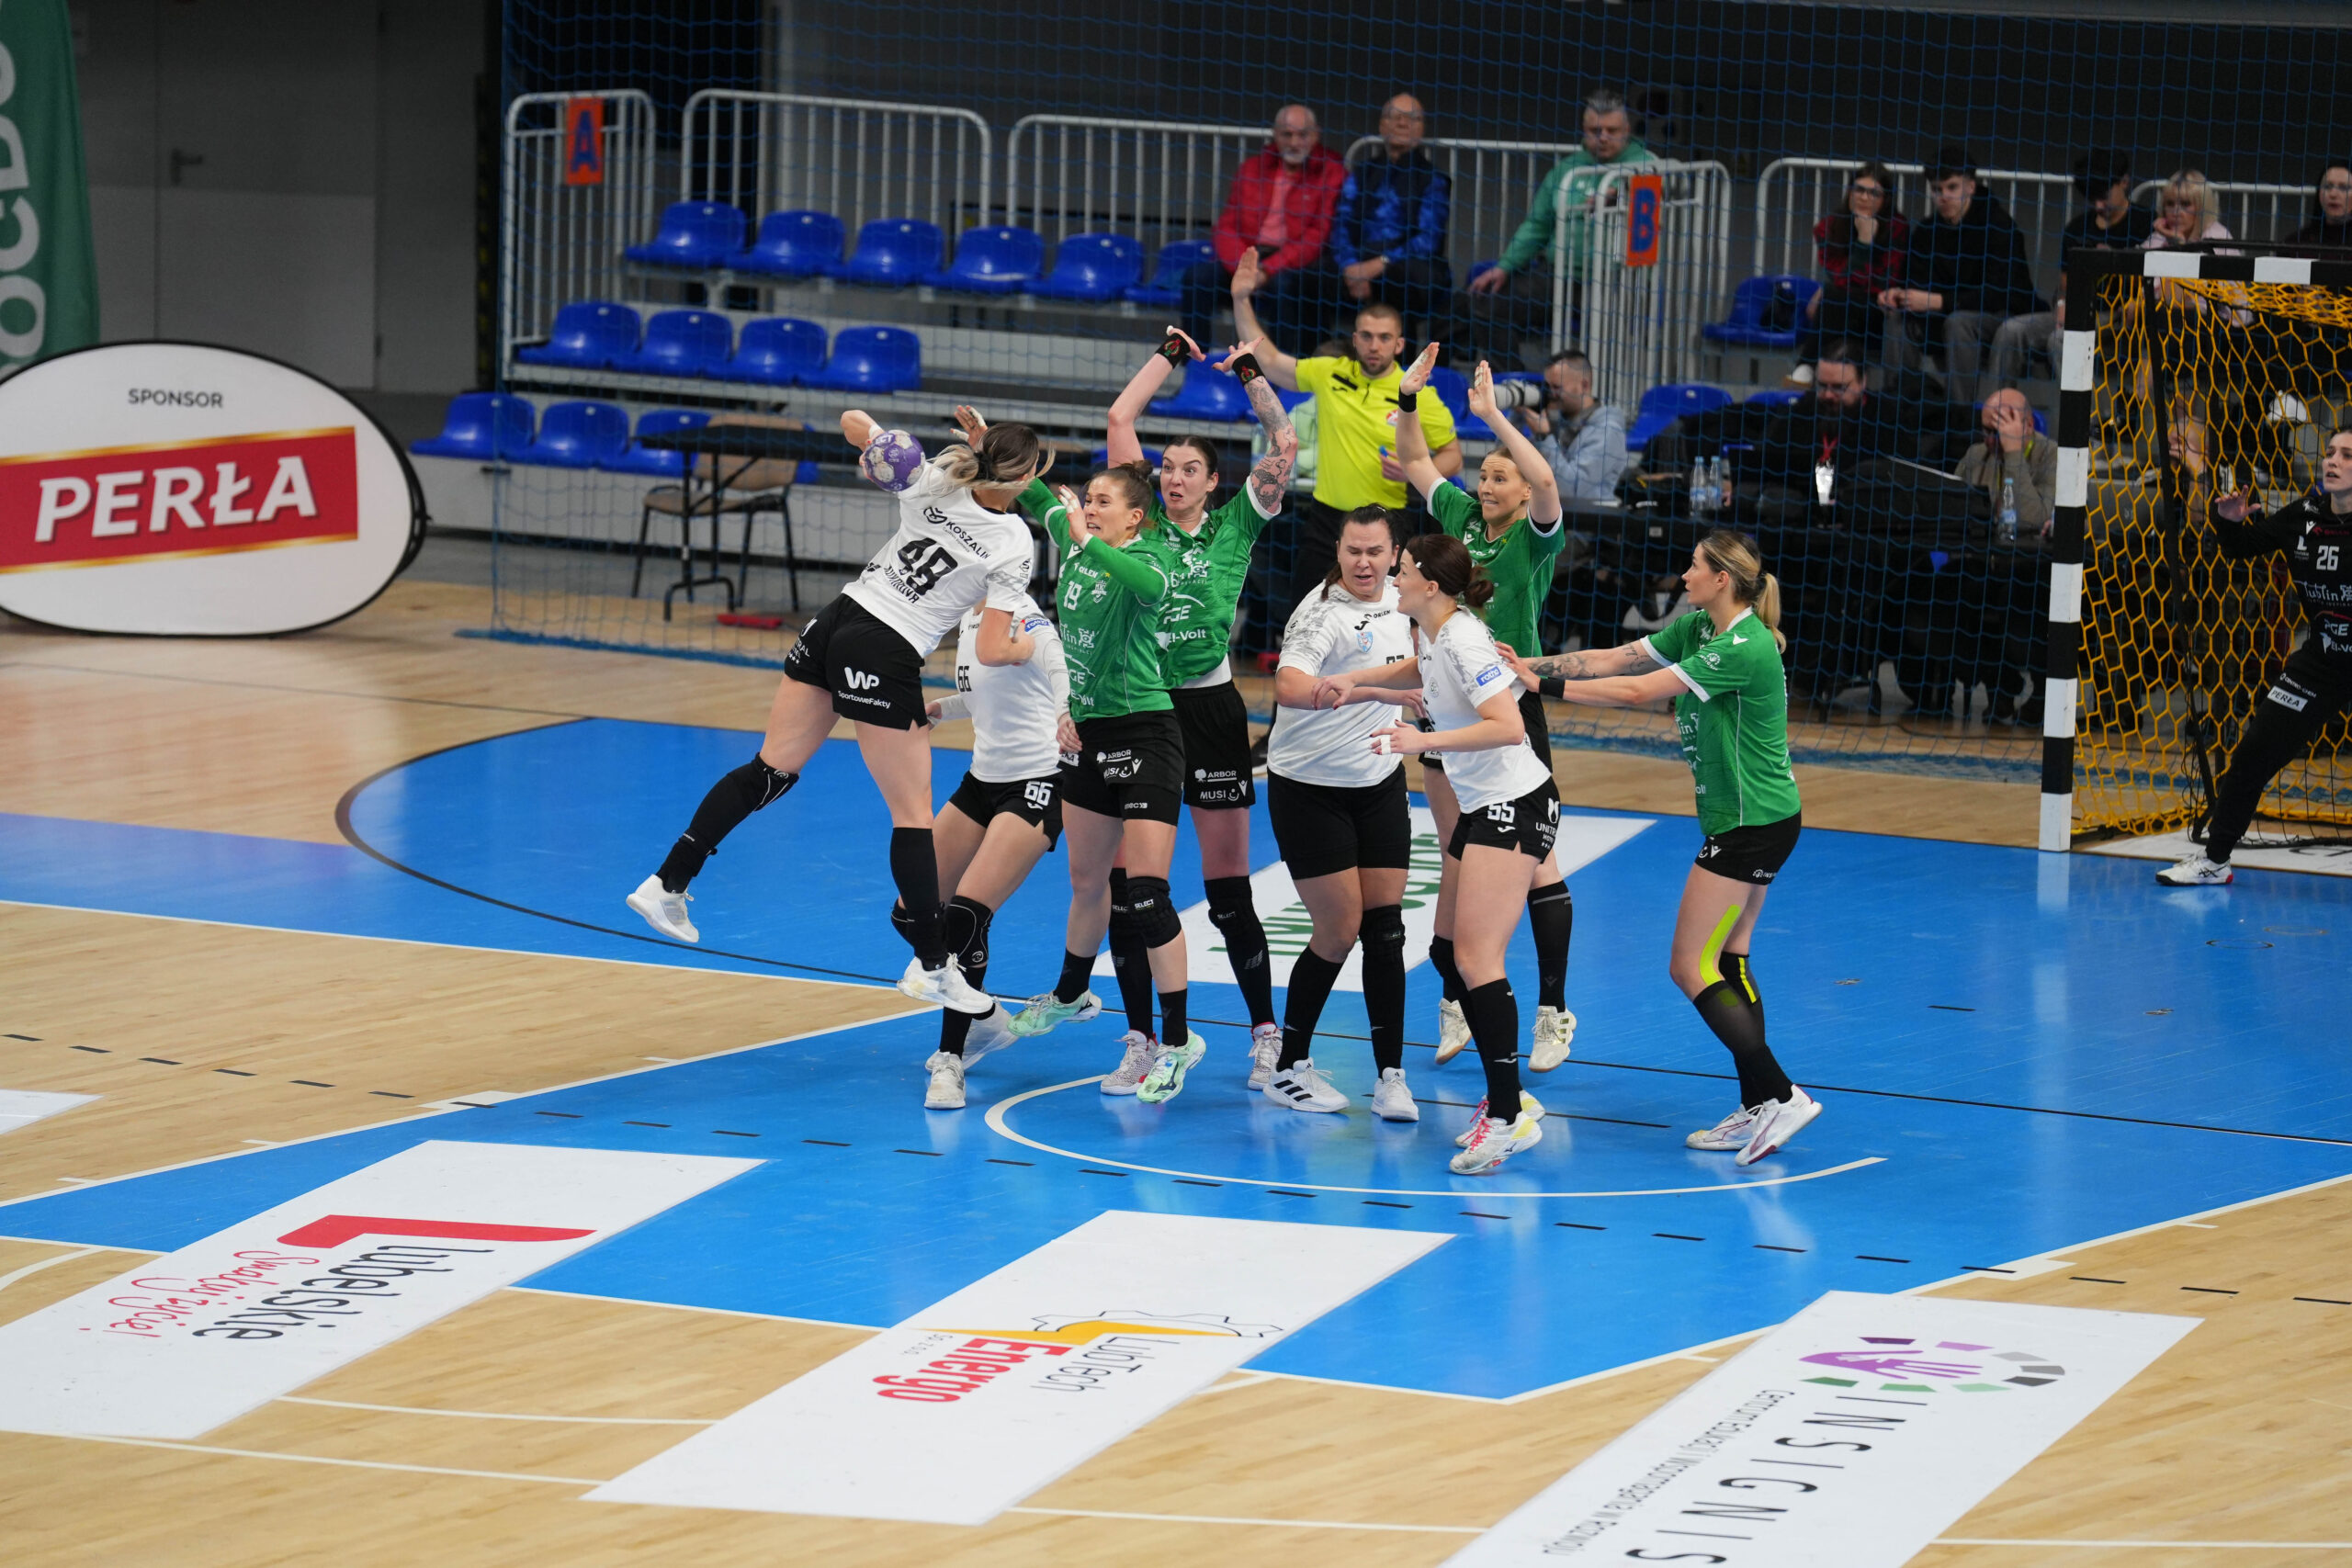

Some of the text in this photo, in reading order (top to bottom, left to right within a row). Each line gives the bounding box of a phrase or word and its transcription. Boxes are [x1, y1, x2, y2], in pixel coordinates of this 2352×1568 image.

[571, 110, 598, 173] A
[1631, 187, 1657, 254] B
[128, 389, 224, 409] SPONSOR
[34, 456, 317, 544] PERŁA
[946, 521, 990, 558] KOSZALIN
[2316, 545, 2340, 571] 26
[1063, 581, 1083, 611] 19
[1373, 609, 1391, 619] ORLEN
[843, 666, 880, 690] WP
[958, 665, 972, 693] 66
[1069, 669, 1086, 685] GE
[1480, 668, 1499, 682] rotho
[837, 690, 891, 709] SportoweFakty
[2270, 689, 2301, 707] PERŁA
[1107, 749, 1132, 760] ARBOR
[1207, 770, 1237, 779] ARBOR
[1023, 781, 1054, 806] 66
[1200, 790, 1227, 800] MUSI
[1487, 799, 1515, 824] 55
[1112, 904, 1128, 912] SELEC
[1134, 898, 1155, 909] SELECT
[873, 1337, 1074, 1403] Energo
[1030, 1336, 1181, 1393] LubTech
[1624, 1394, 1928, 1564] INSIGNIS
